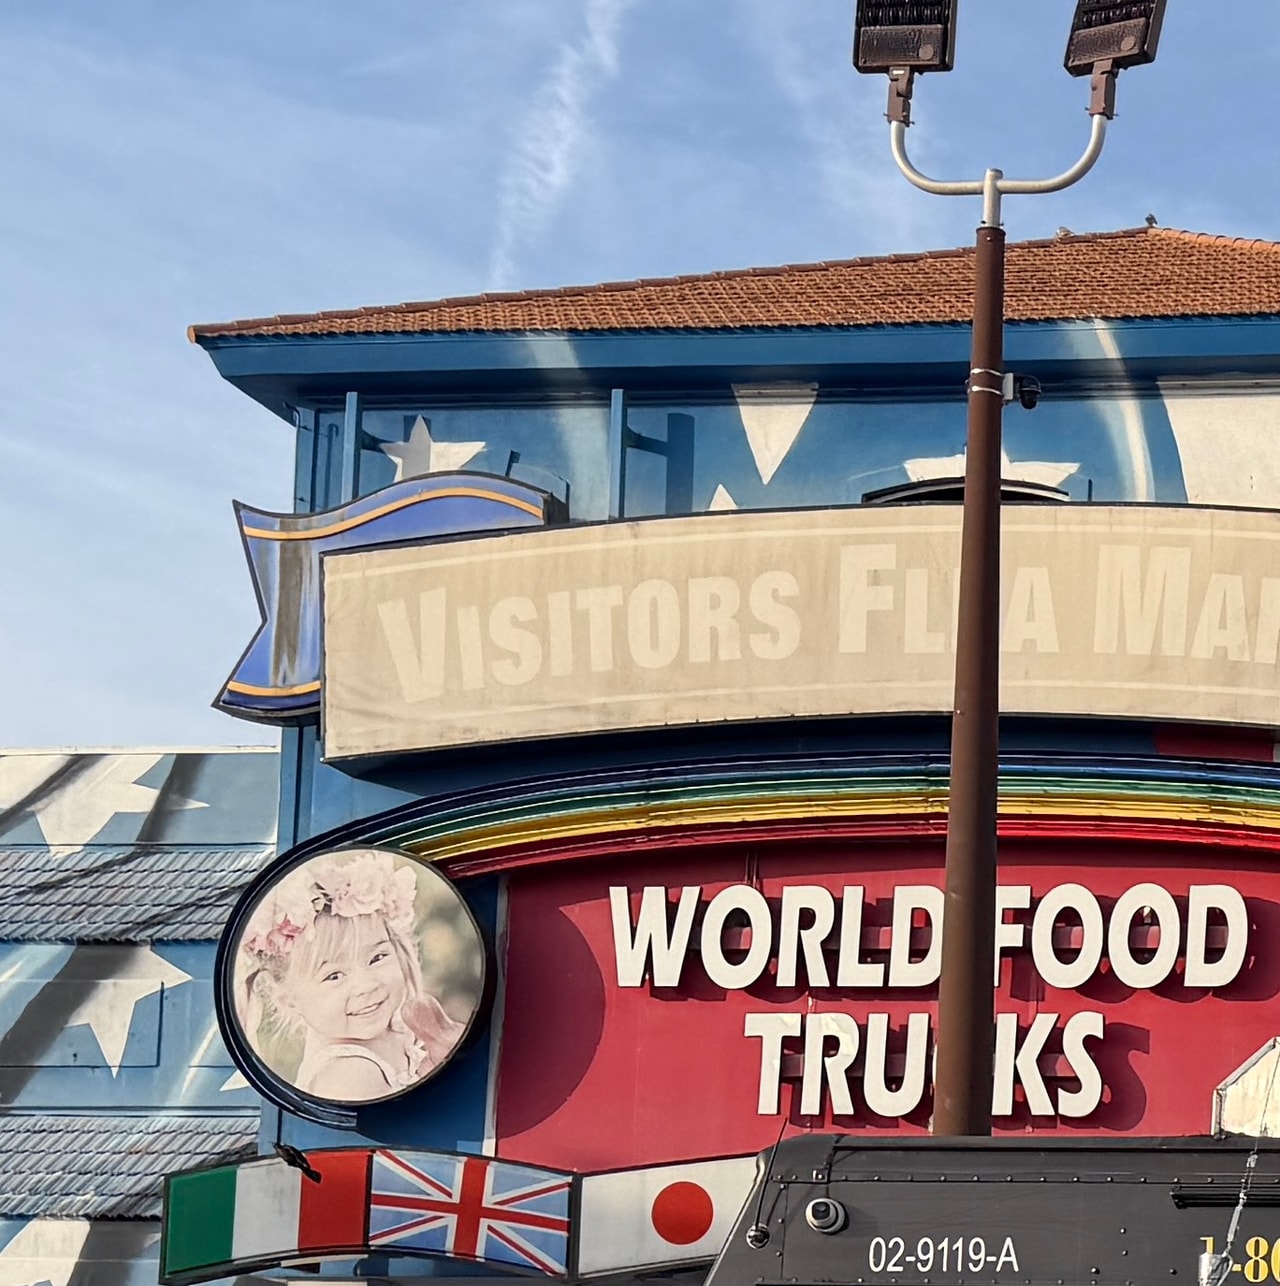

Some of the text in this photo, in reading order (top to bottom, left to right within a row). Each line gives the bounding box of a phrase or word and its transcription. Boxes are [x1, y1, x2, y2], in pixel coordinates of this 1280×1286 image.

[378, 571, 801, 703] VISITORS
[839, 544, 1059, 653] FLA
[609, 882, 1249, 989] WORLD FOOD
[744, 1010, 1105, 1118] TRUKS
[868, 1236, 1019, 1273] 02-9119-A
